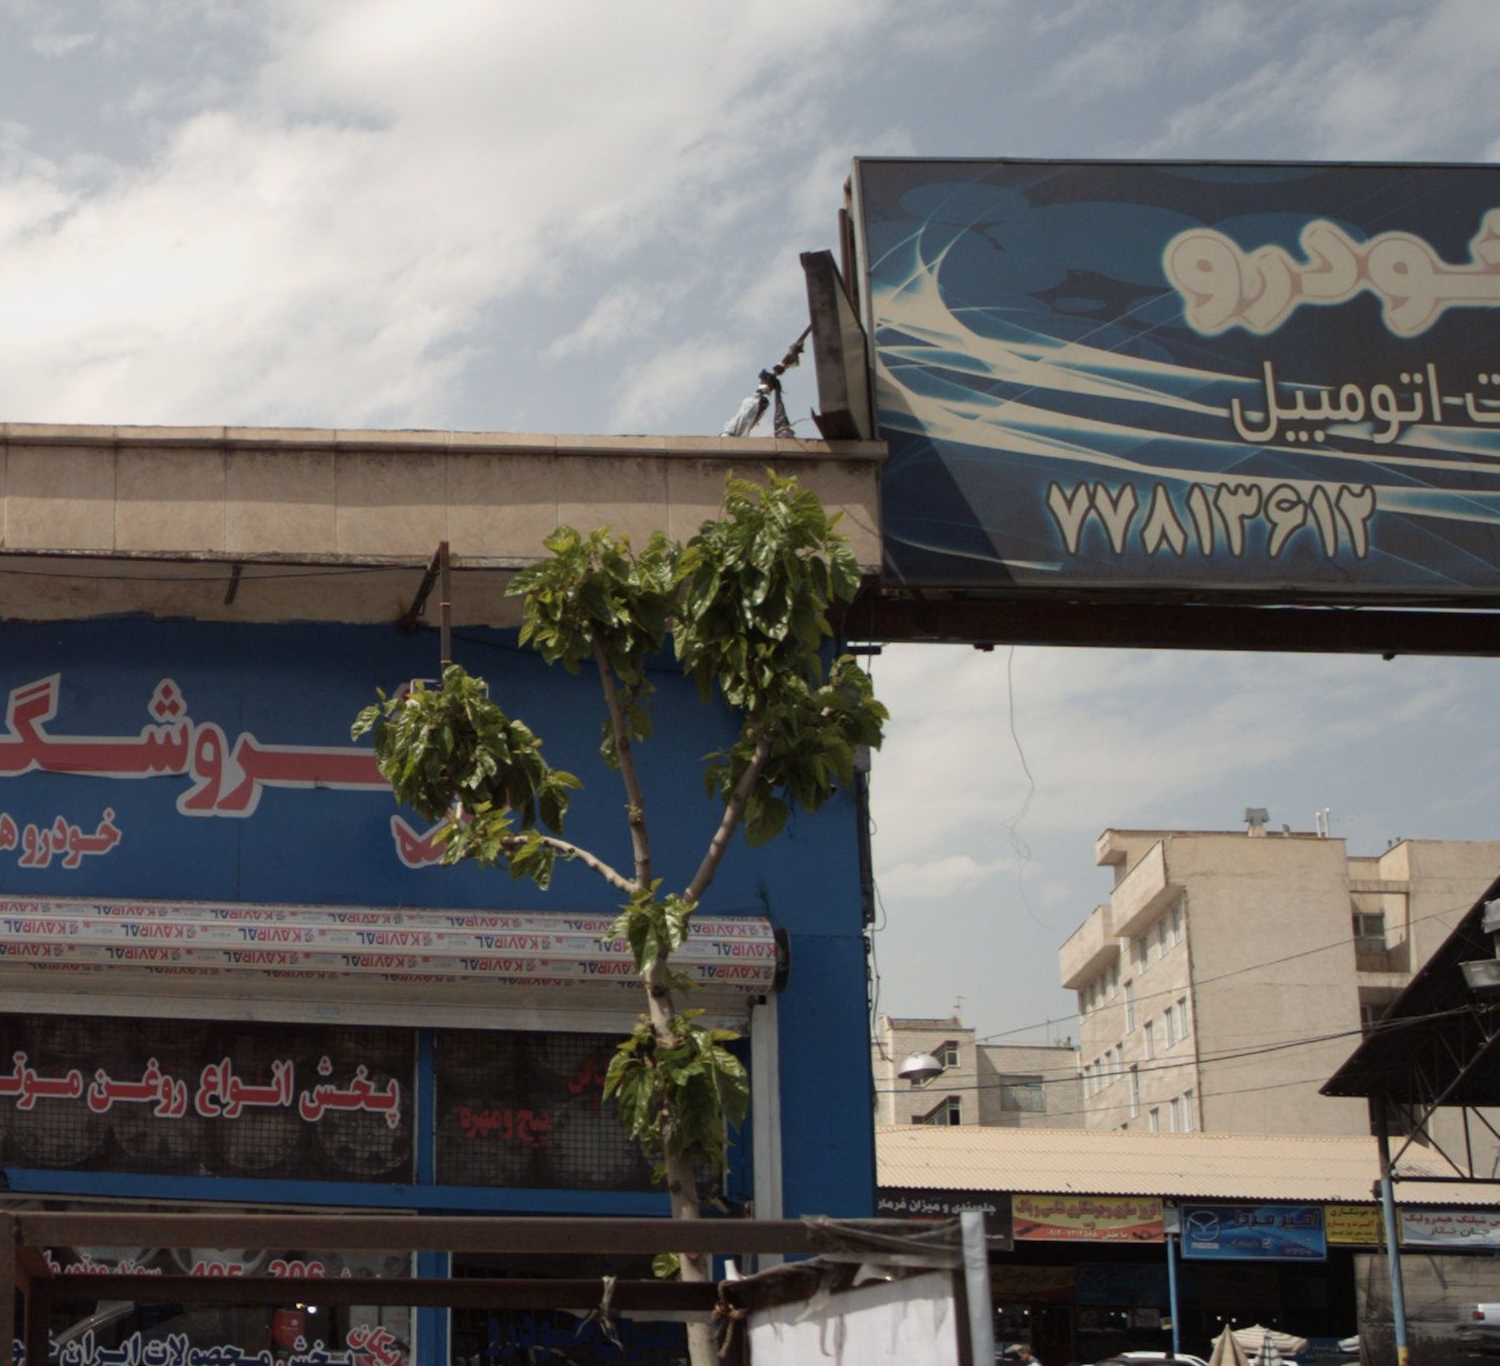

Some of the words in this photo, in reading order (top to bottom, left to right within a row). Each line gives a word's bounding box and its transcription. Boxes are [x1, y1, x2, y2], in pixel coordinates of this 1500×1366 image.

[1229, 359, 1443, 445] اتومبیل
[1046, 479, 1377, 559] ۷۷۸۱۳۶۱۲
[86, 1057, 189, 1118] روغن
[195, 1055, 295, 1118] انواع
[298, 1055, 401, 1128] پخش
